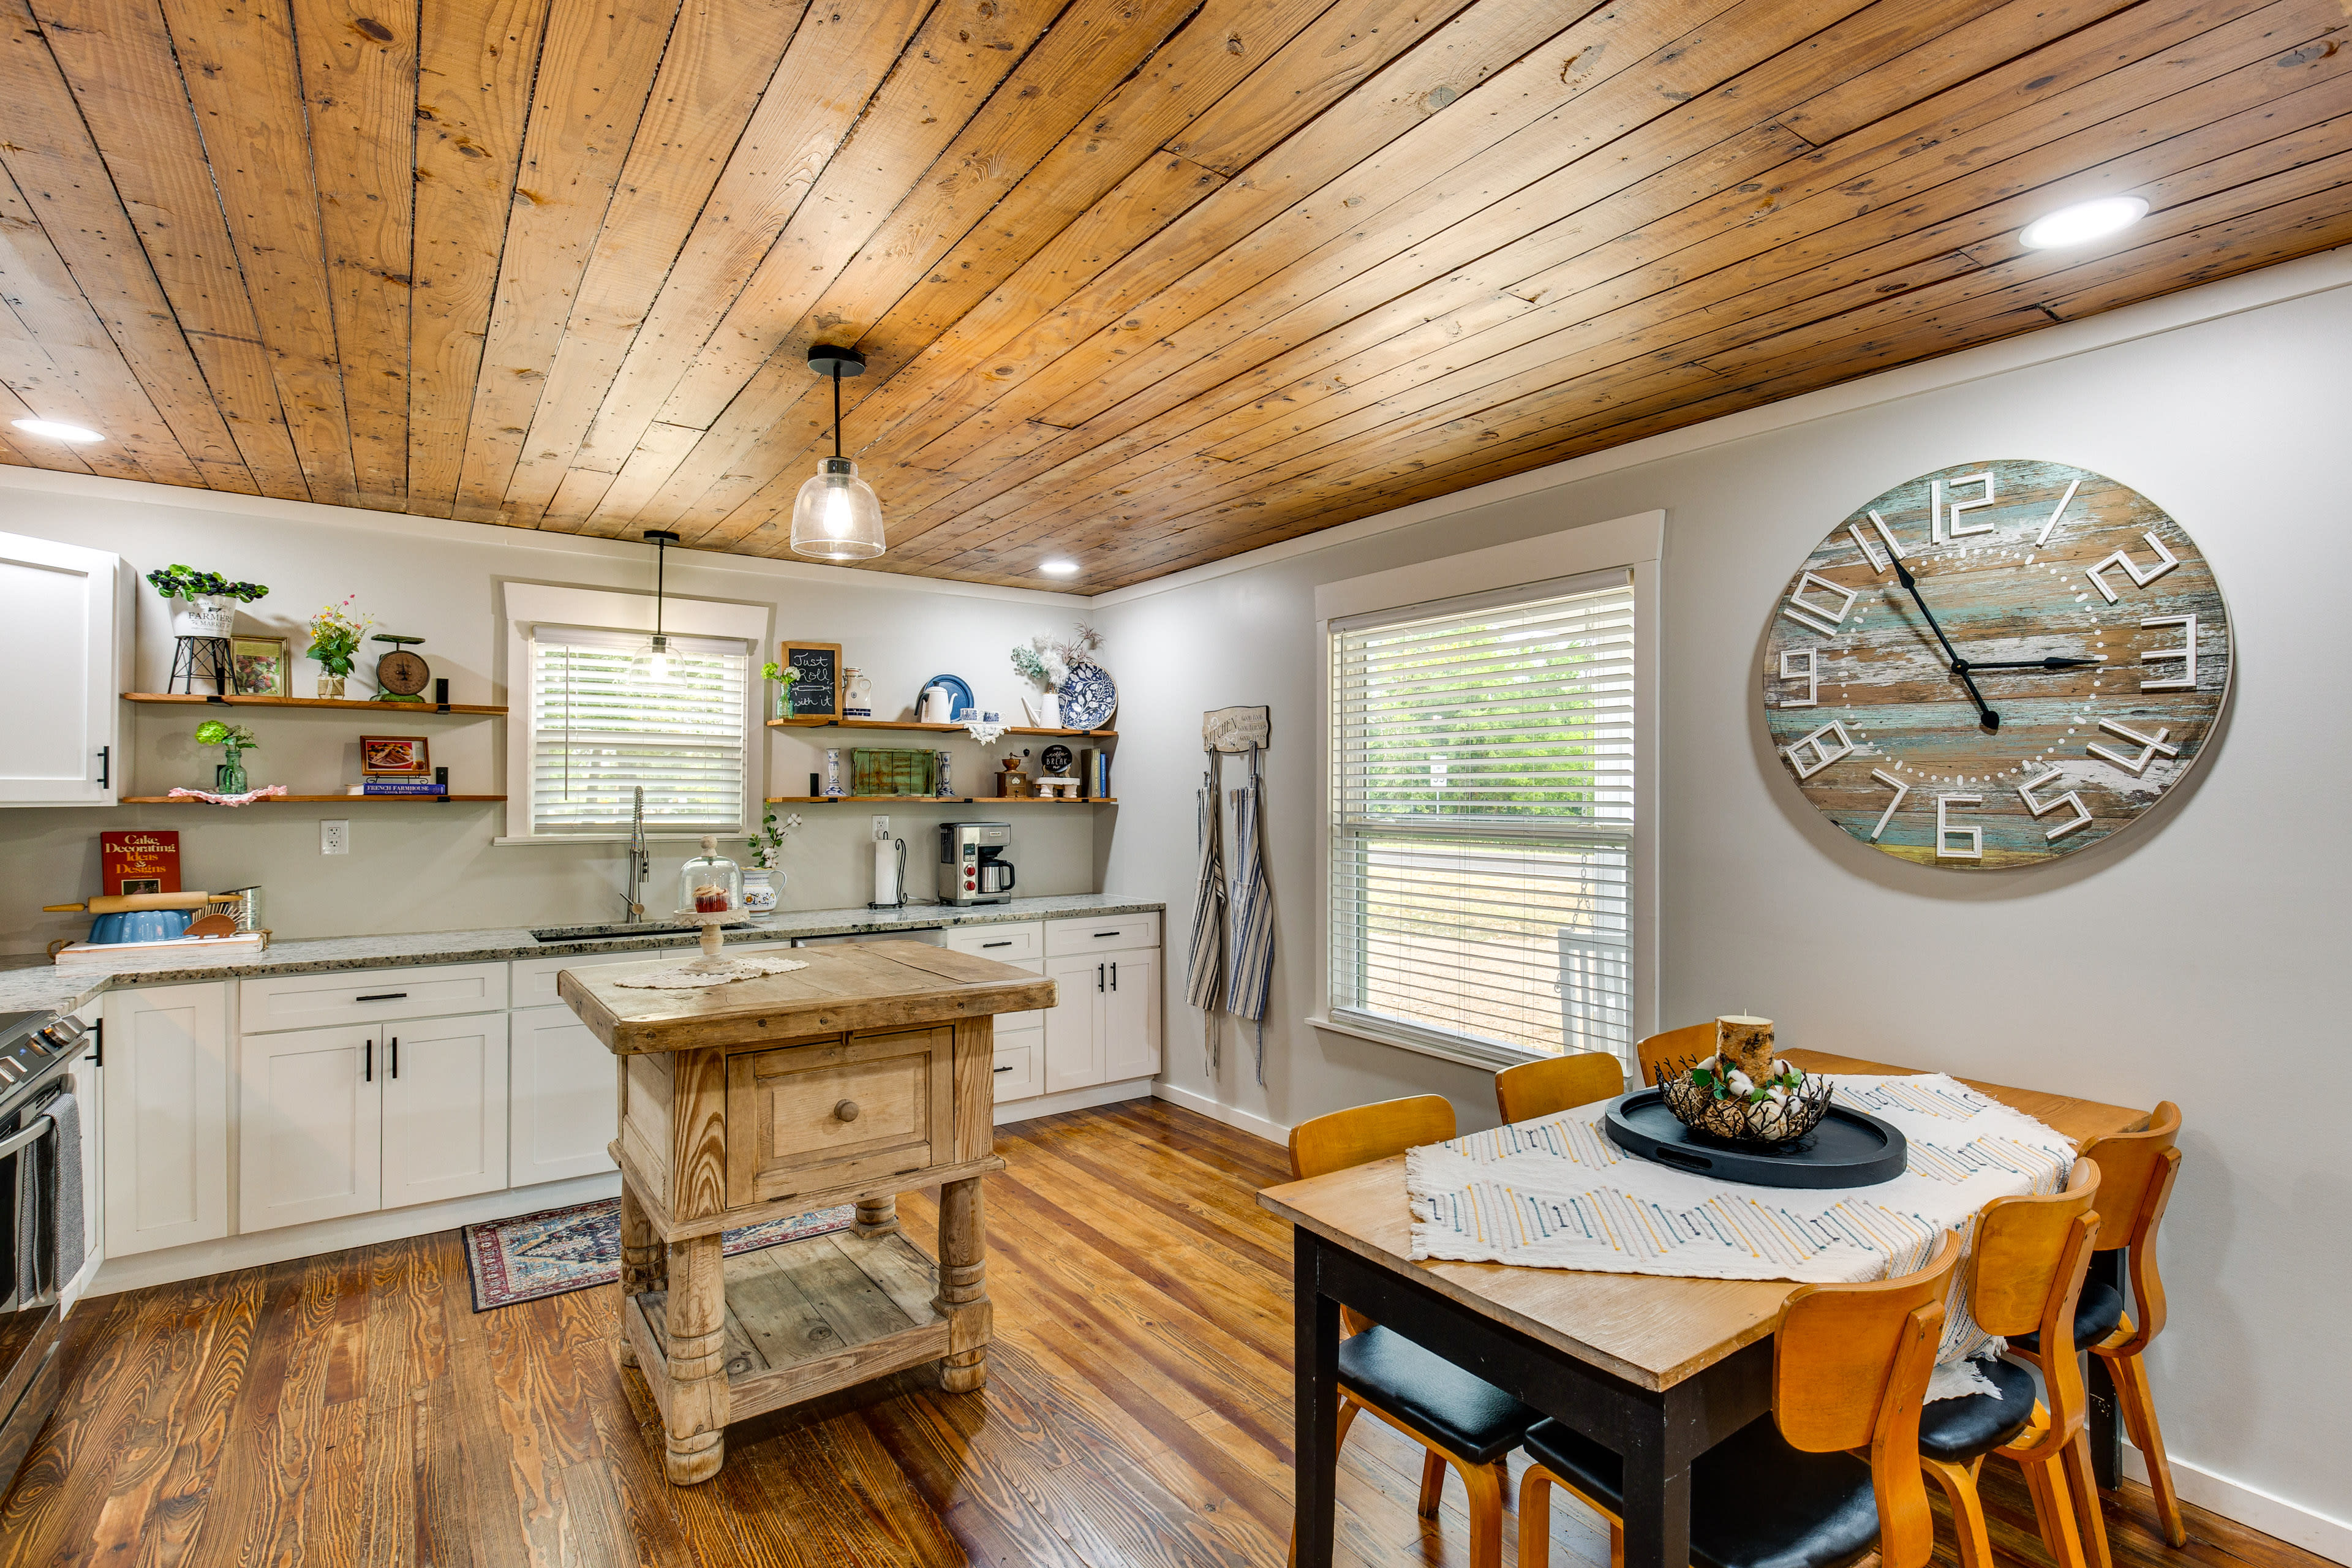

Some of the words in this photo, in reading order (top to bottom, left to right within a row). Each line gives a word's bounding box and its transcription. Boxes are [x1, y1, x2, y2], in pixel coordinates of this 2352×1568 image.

[1931, 471, 1995, 544] 12
[2035, 479, 2082, 548] 1
[1847, 508, 1907, 574] 11
[2085, 530, 2179, 605] 2
[188, 612, 233, 623] FARMERS
[1783, 571, 1859, 638] 10
[794, 652, 828, 667] Just
[798, 668, 830, 682] Roll
[1779, 647, 1817, 707] 9
[2140, 613, 2197, 688] 3
[794, 697, 818, 707] with
[820, 695, 832, 706] it
[1204, 715, 1237, 747] KITCHEN
[1785, 719, 1855, 779] 8
[2086, 717, 2179, 772] 4
[1871, 767, 1910, 840] 7
[1937, 794, 1983, 859] 6
[2018, 767, 2093, 840] 5
[105, 843, 176, 853] Decorating
[116, 864, 167, 874] Designs
[124, 834, 159, 845] Cake
[127, 852, 159, 861] Ideas
